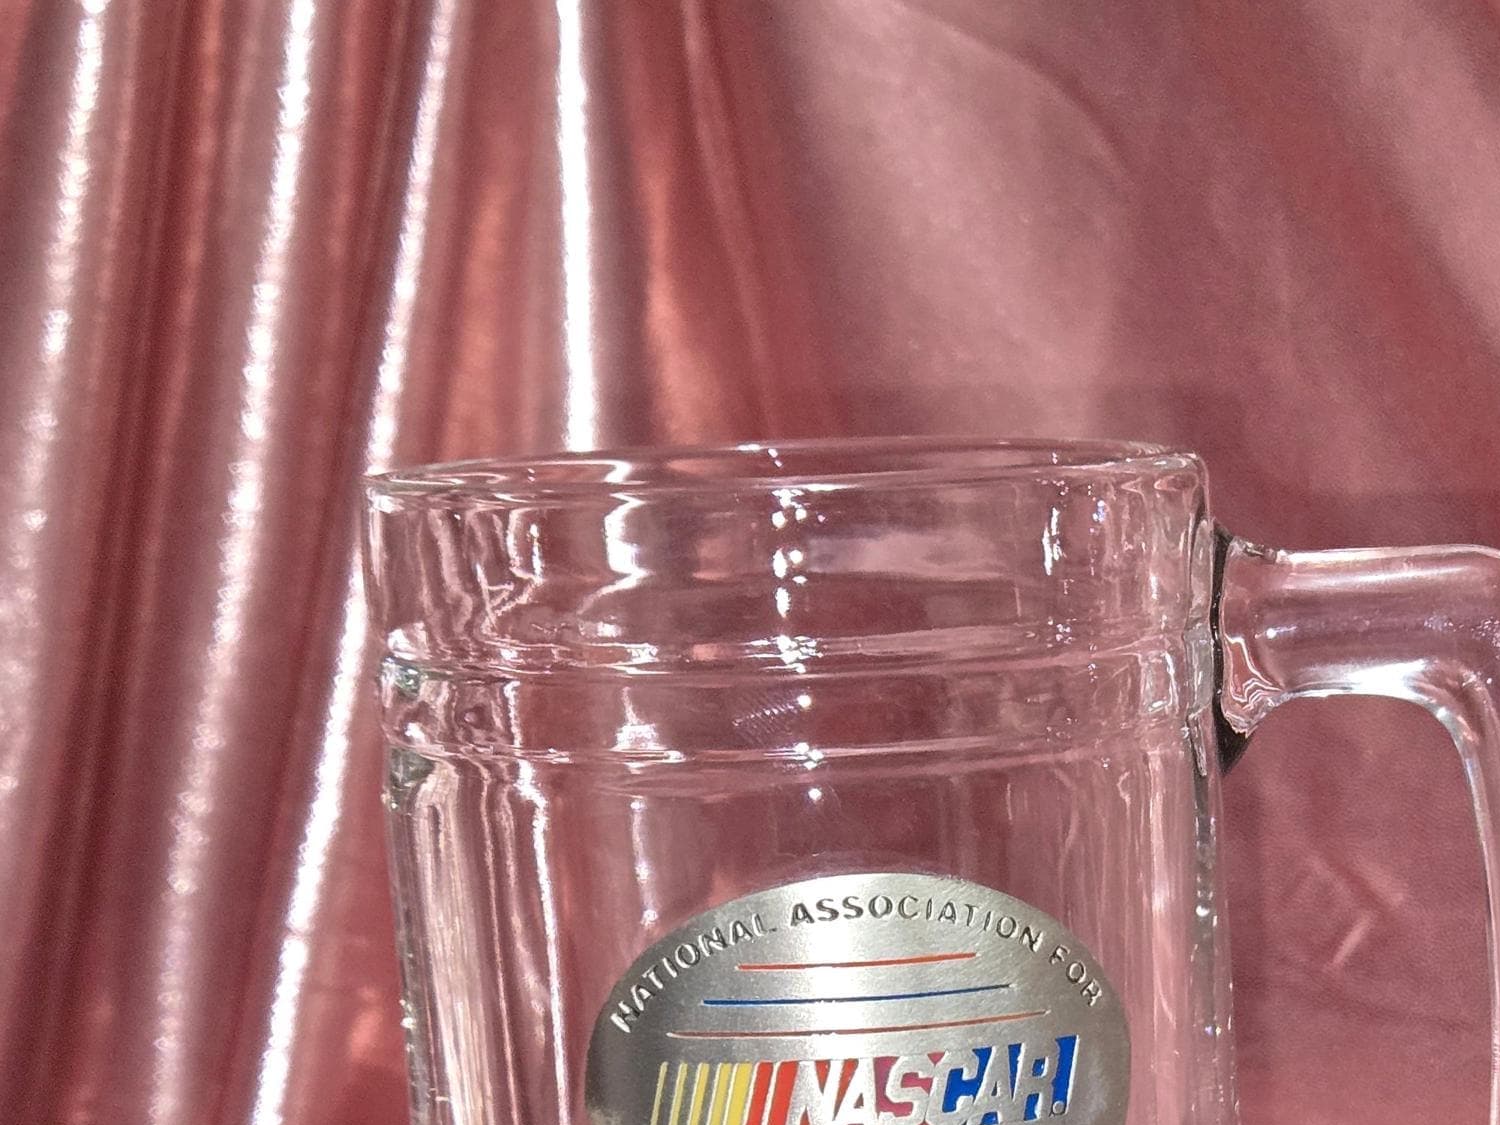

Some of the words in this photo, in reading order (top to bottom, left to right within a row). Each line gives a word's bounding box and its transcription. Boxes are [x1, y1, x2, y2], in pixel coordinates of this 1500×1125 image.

[610, 915, 777, 1033] NATIONAL
[790, 894, 1043, 953] ASSOCIATION
[1049, 945, 1104, 1007] FOR
